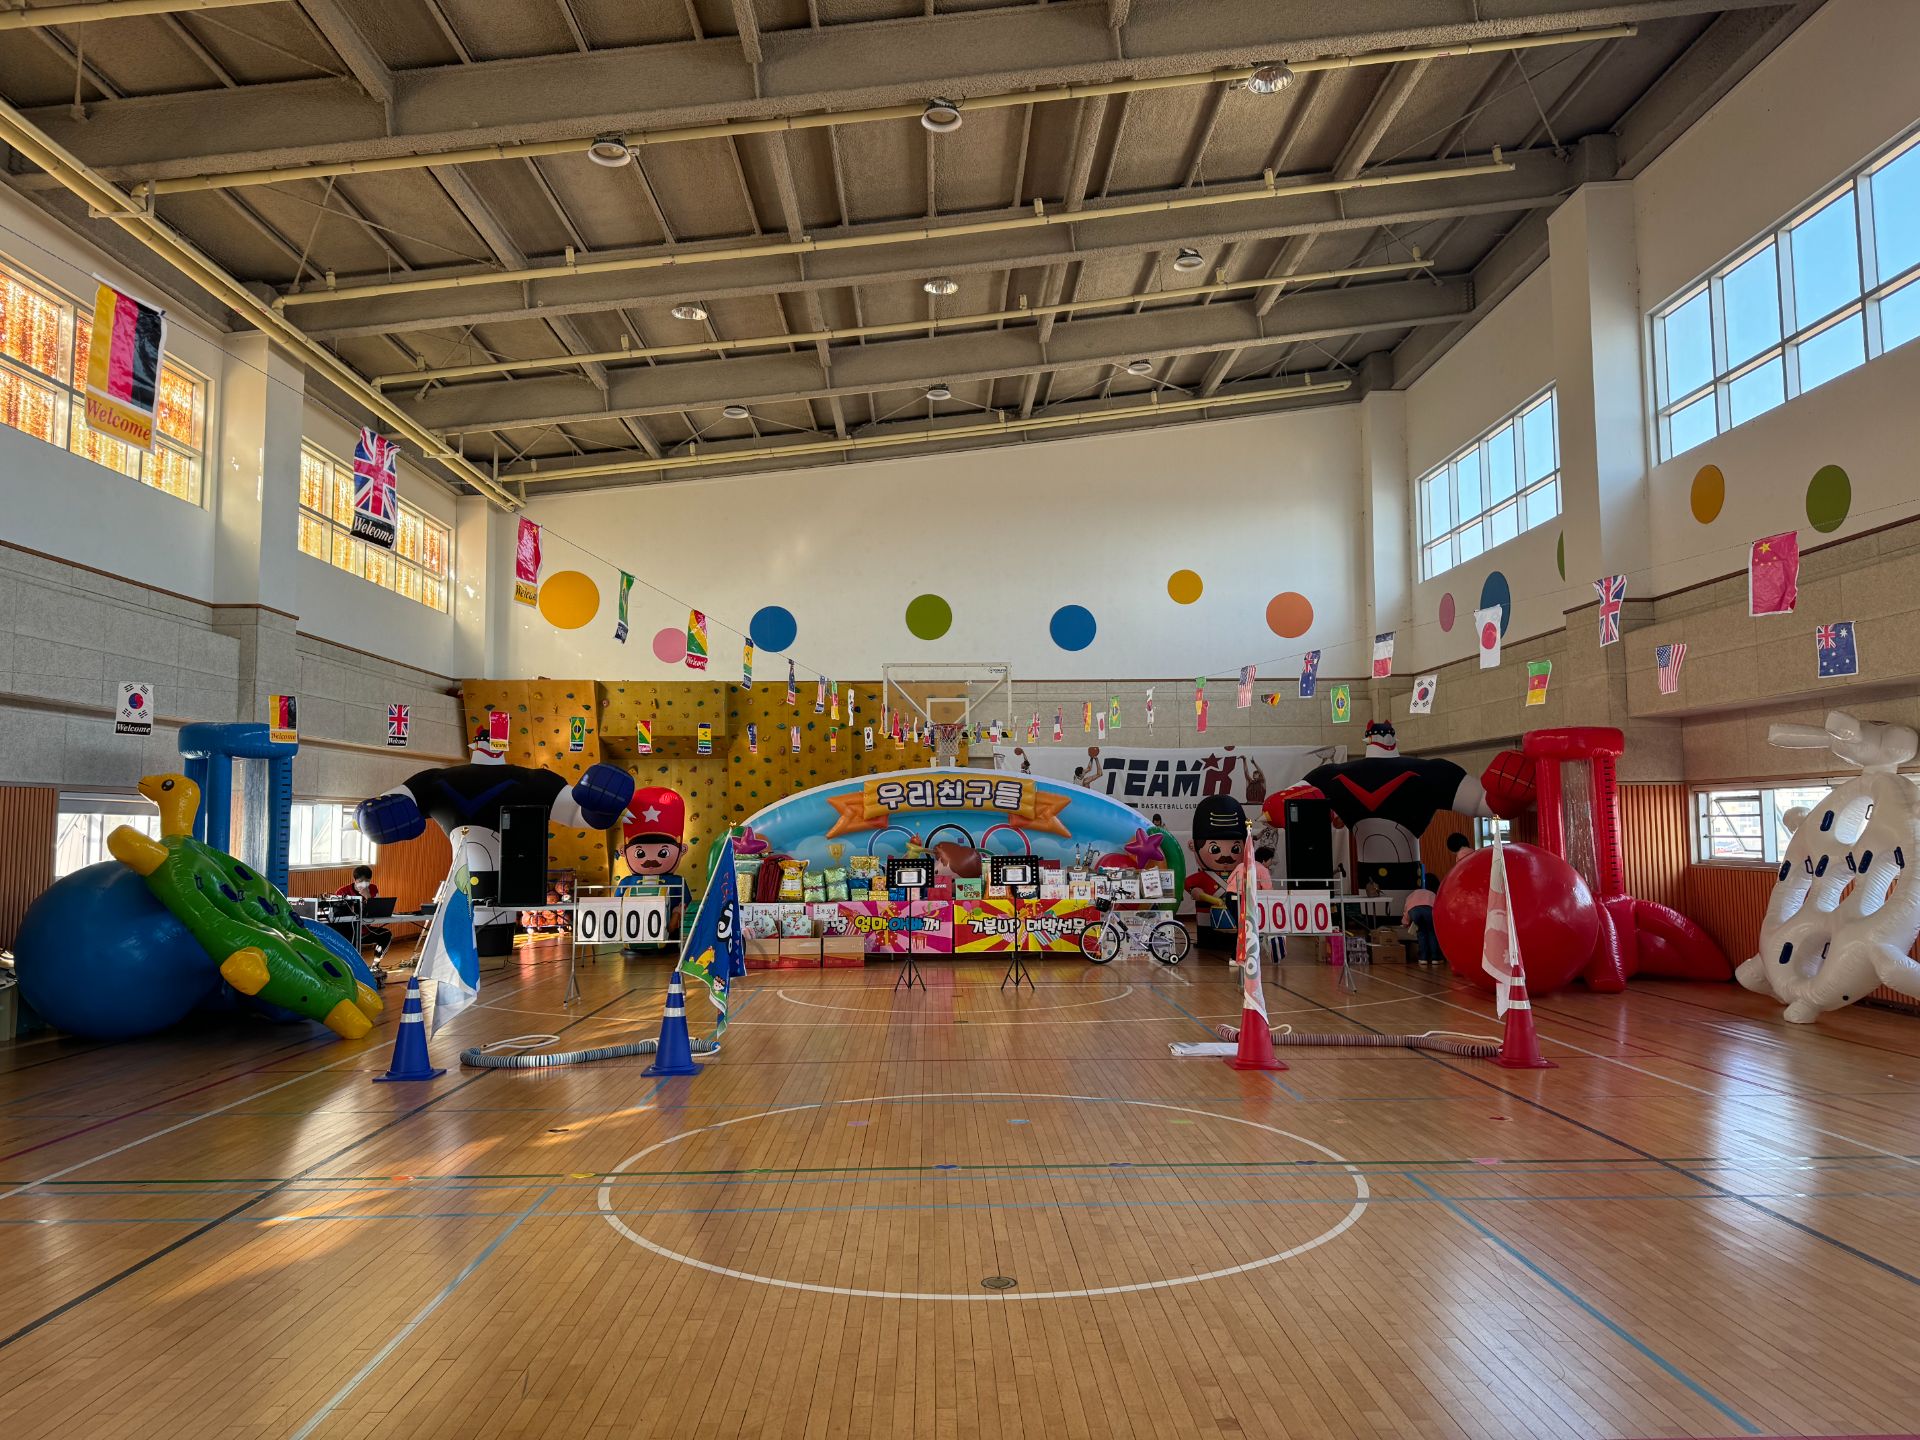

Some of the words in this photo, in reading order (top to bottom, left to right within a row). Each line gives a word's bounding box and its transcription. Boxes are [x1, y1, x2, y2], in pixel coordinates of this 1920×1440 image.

[86, 397, 152, 442] Welcome
[353, 515, 394, 544] Welcome
[117, 723, 151, 733] Welcome
[877, 779, 1023, 810] 우리친구들
